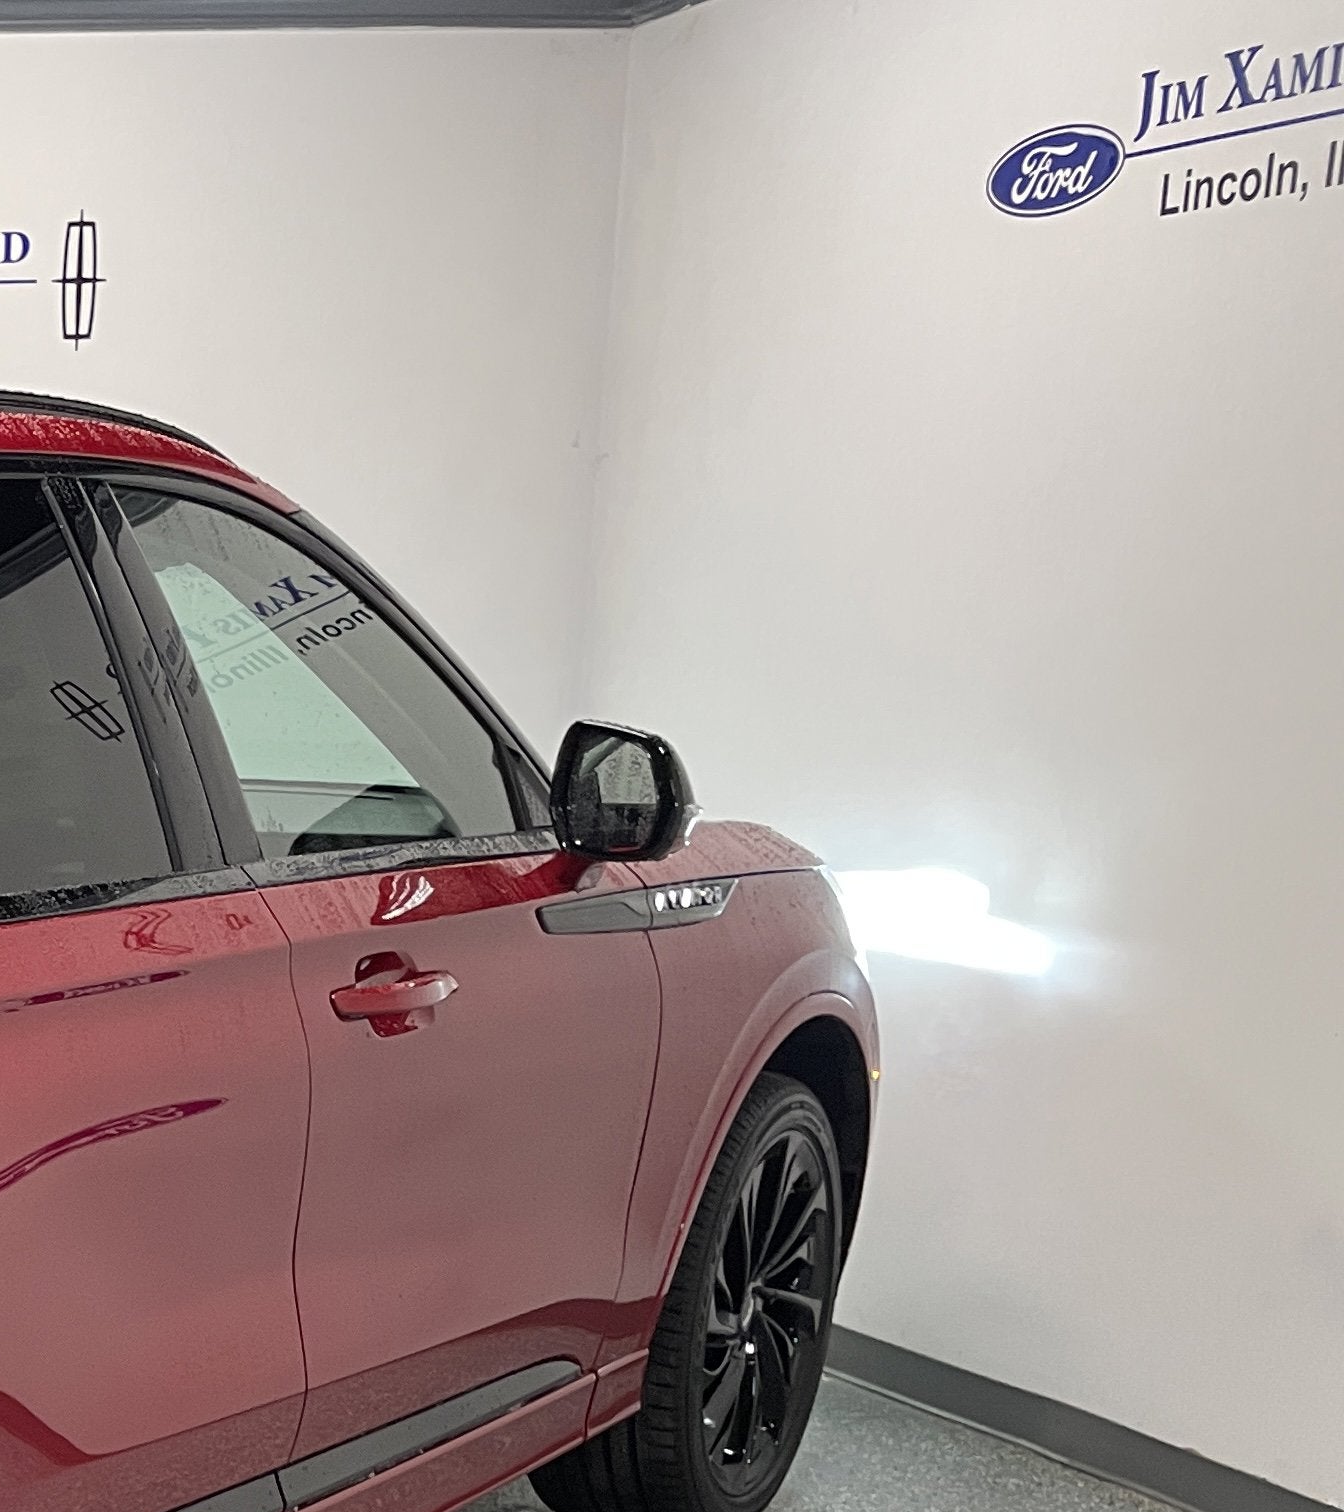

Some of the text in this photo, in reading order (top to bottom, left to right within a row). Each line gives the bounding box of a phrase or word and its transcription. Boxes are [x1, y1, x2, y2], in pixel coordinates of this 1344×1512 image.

[1133, 42, 1344, 143] JIM XAMI
[1010, 141, 1099, 205] Ford
[1158, 151, 1310, 217] Lincoln,
